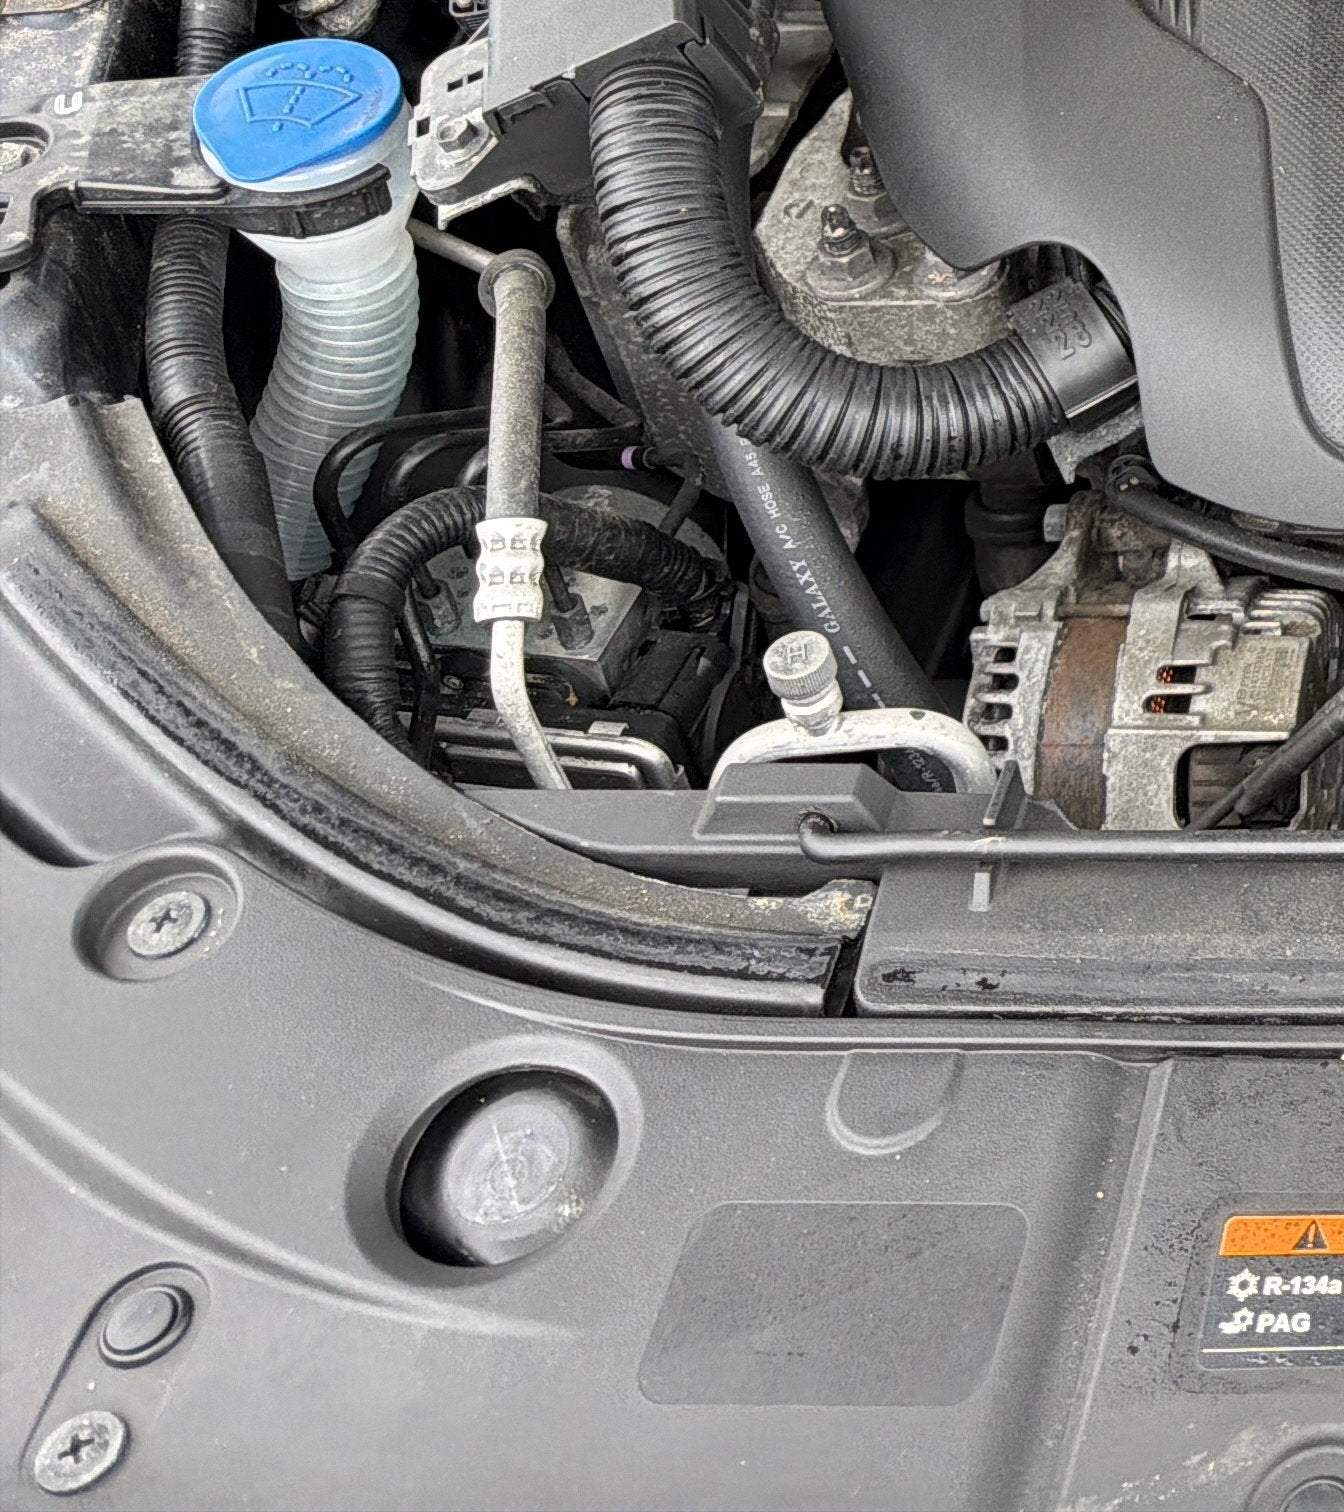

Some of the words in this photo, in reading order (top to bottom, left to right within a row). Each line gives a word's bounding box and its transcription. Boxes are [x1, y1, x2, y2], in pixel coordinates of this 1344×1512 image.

[744, 451, 765, 476] A45
[757, 482, 781, 520] HOSE
[775, 523, 798, 550] A/C
[788, 558, 841, 634] GALAXY
[1262, 1275, 1344, 1296] R-134a
[1255, 1313, 1312, 1334] PAG
